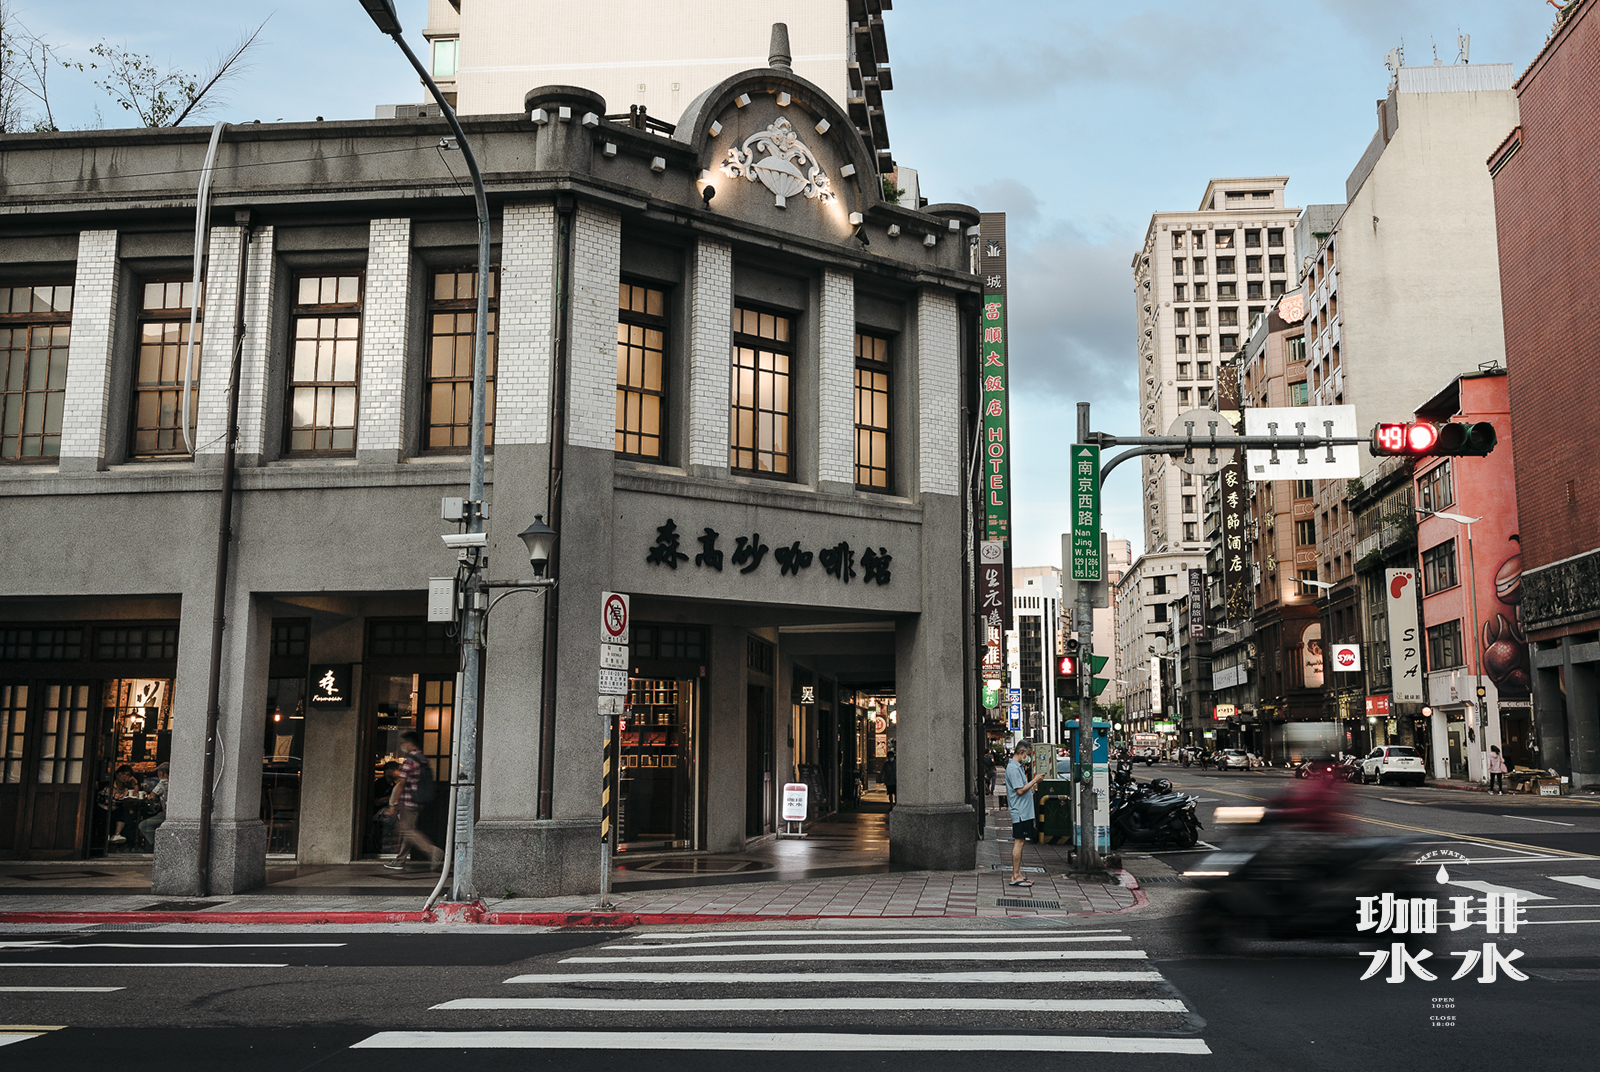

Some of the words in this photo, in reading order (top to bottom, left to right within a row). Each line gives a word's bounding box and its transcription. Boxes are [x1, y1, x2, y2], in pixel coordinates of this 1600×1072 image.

[986, 275, 1001, 288] 城
[984, 303, 1004, 417] 富順大飯店
[1379, 426, 1404, 450] 49
[988, 427, 1004, 506] HOTEL
[1077, 460, 1093, 526] 南京西路
[647, 519, 892, 586] 森高砂咖啡館
[1075, 539, 1092, 548] Jing
[1191, 625, 1203, 634] P
[1338, 654, 1355, 664] SYM
[1403, 628, 1418, 678] SPA
